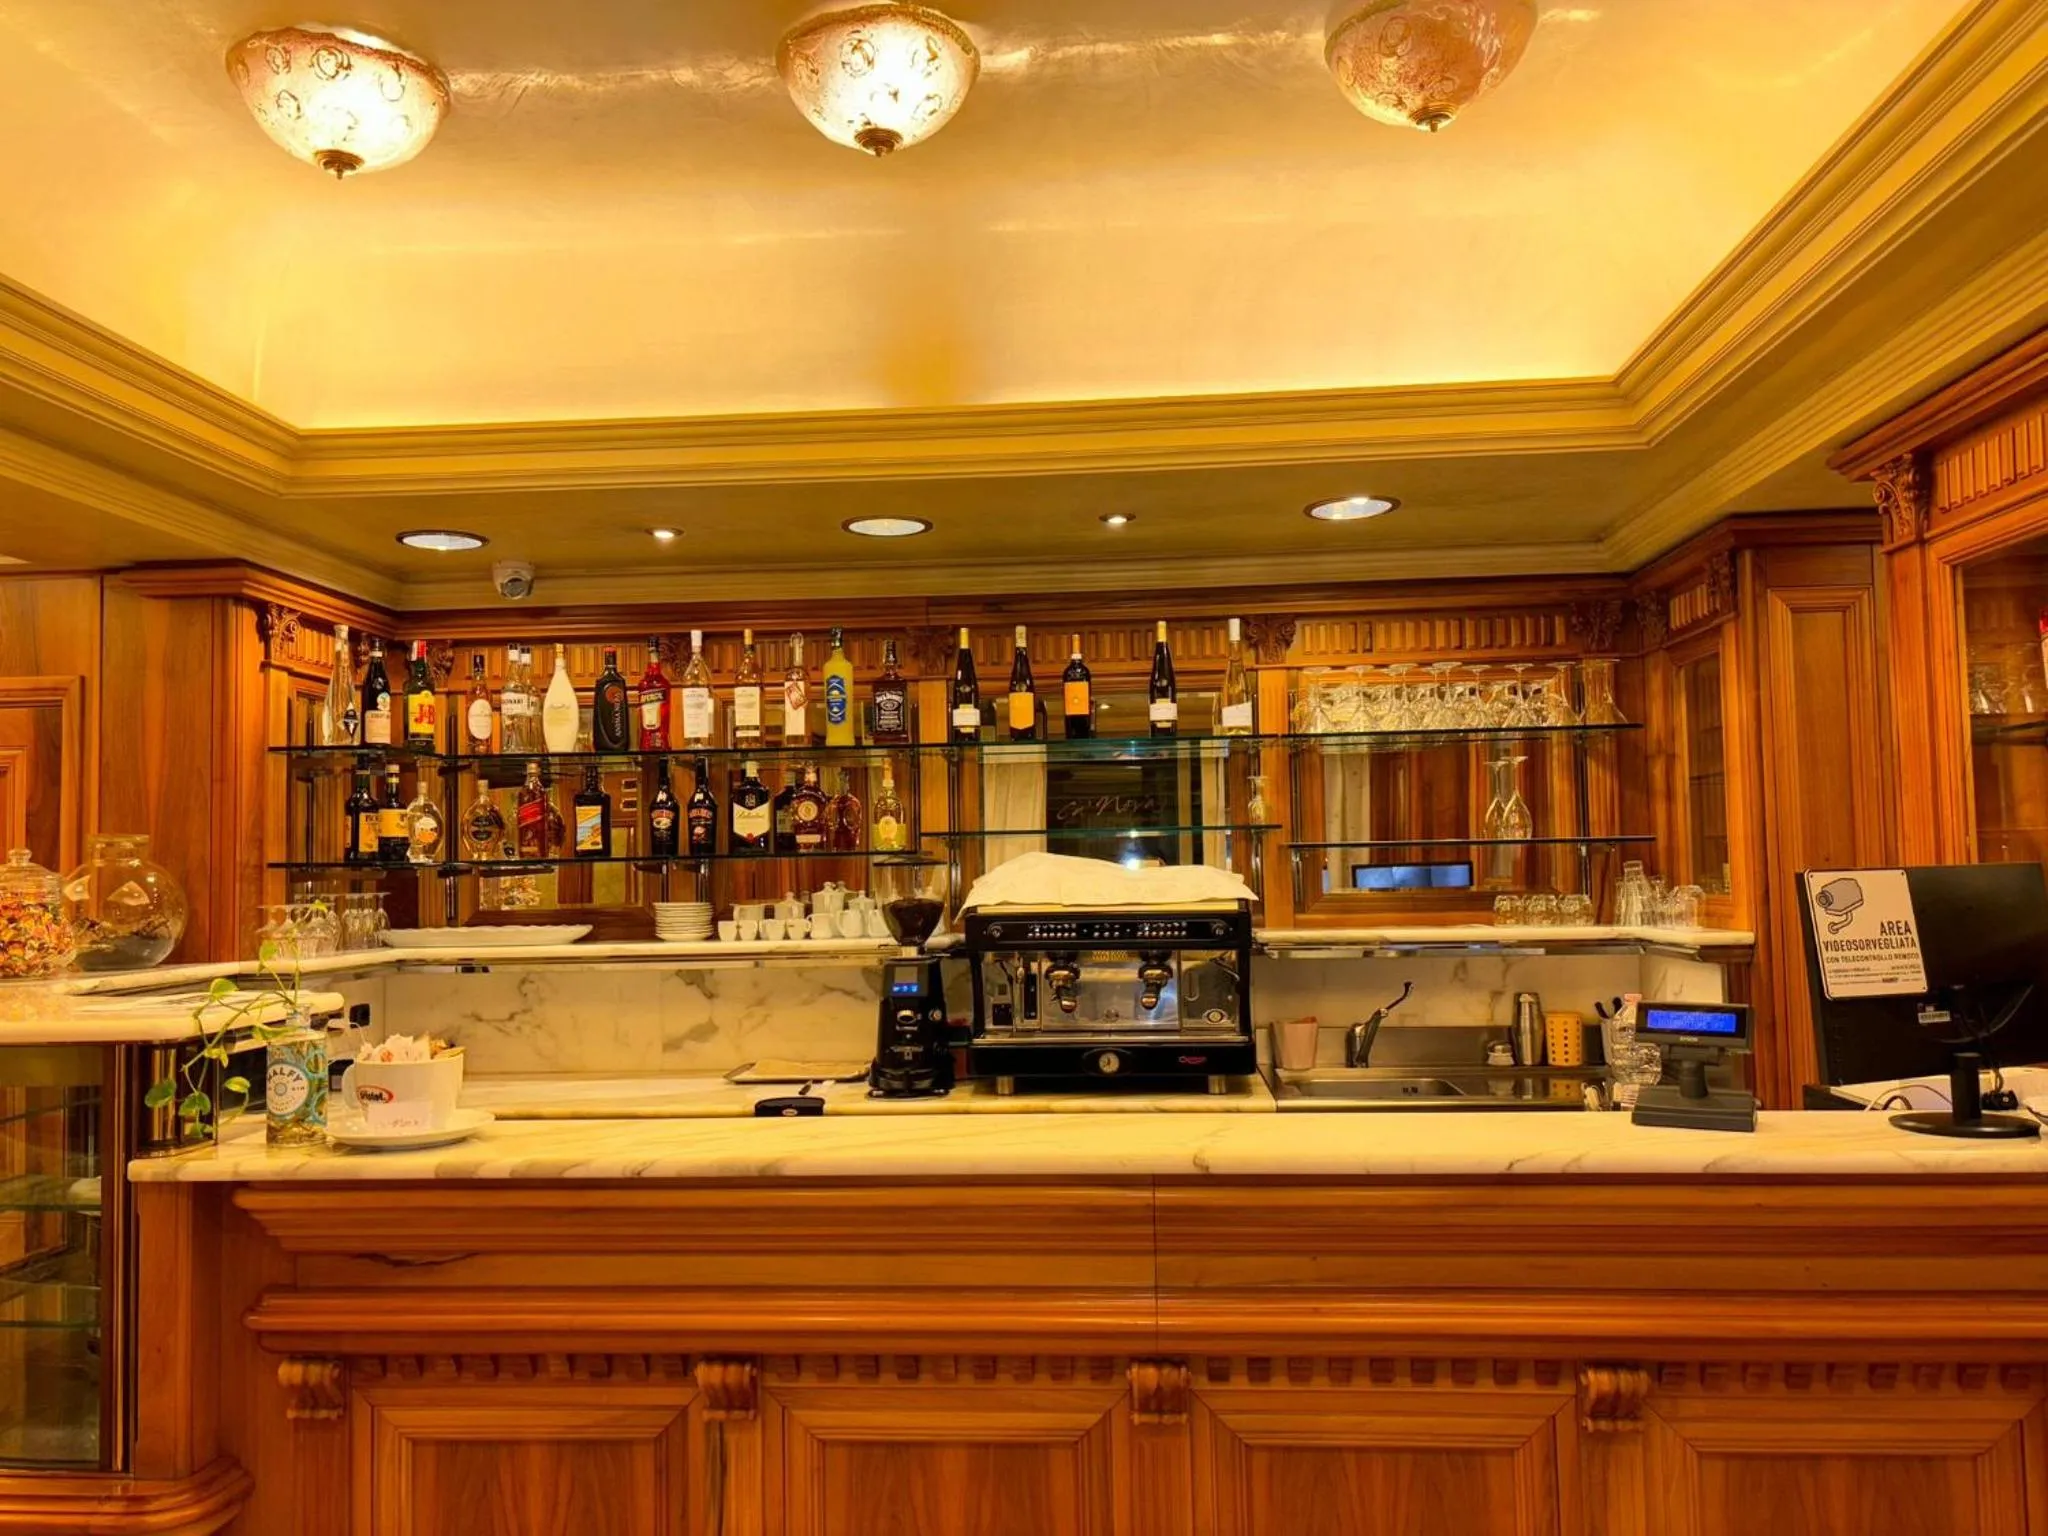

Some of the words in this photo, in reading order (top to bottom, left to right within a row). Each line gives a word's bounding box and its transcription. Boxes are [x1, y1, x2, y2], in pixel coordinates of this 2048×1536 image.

[1880, 920, 1912, 936] AREA
[1823, 937, 1917, 952] VIDEOSORVEGLIATA
[1826, 954, 1839, 964] CON
